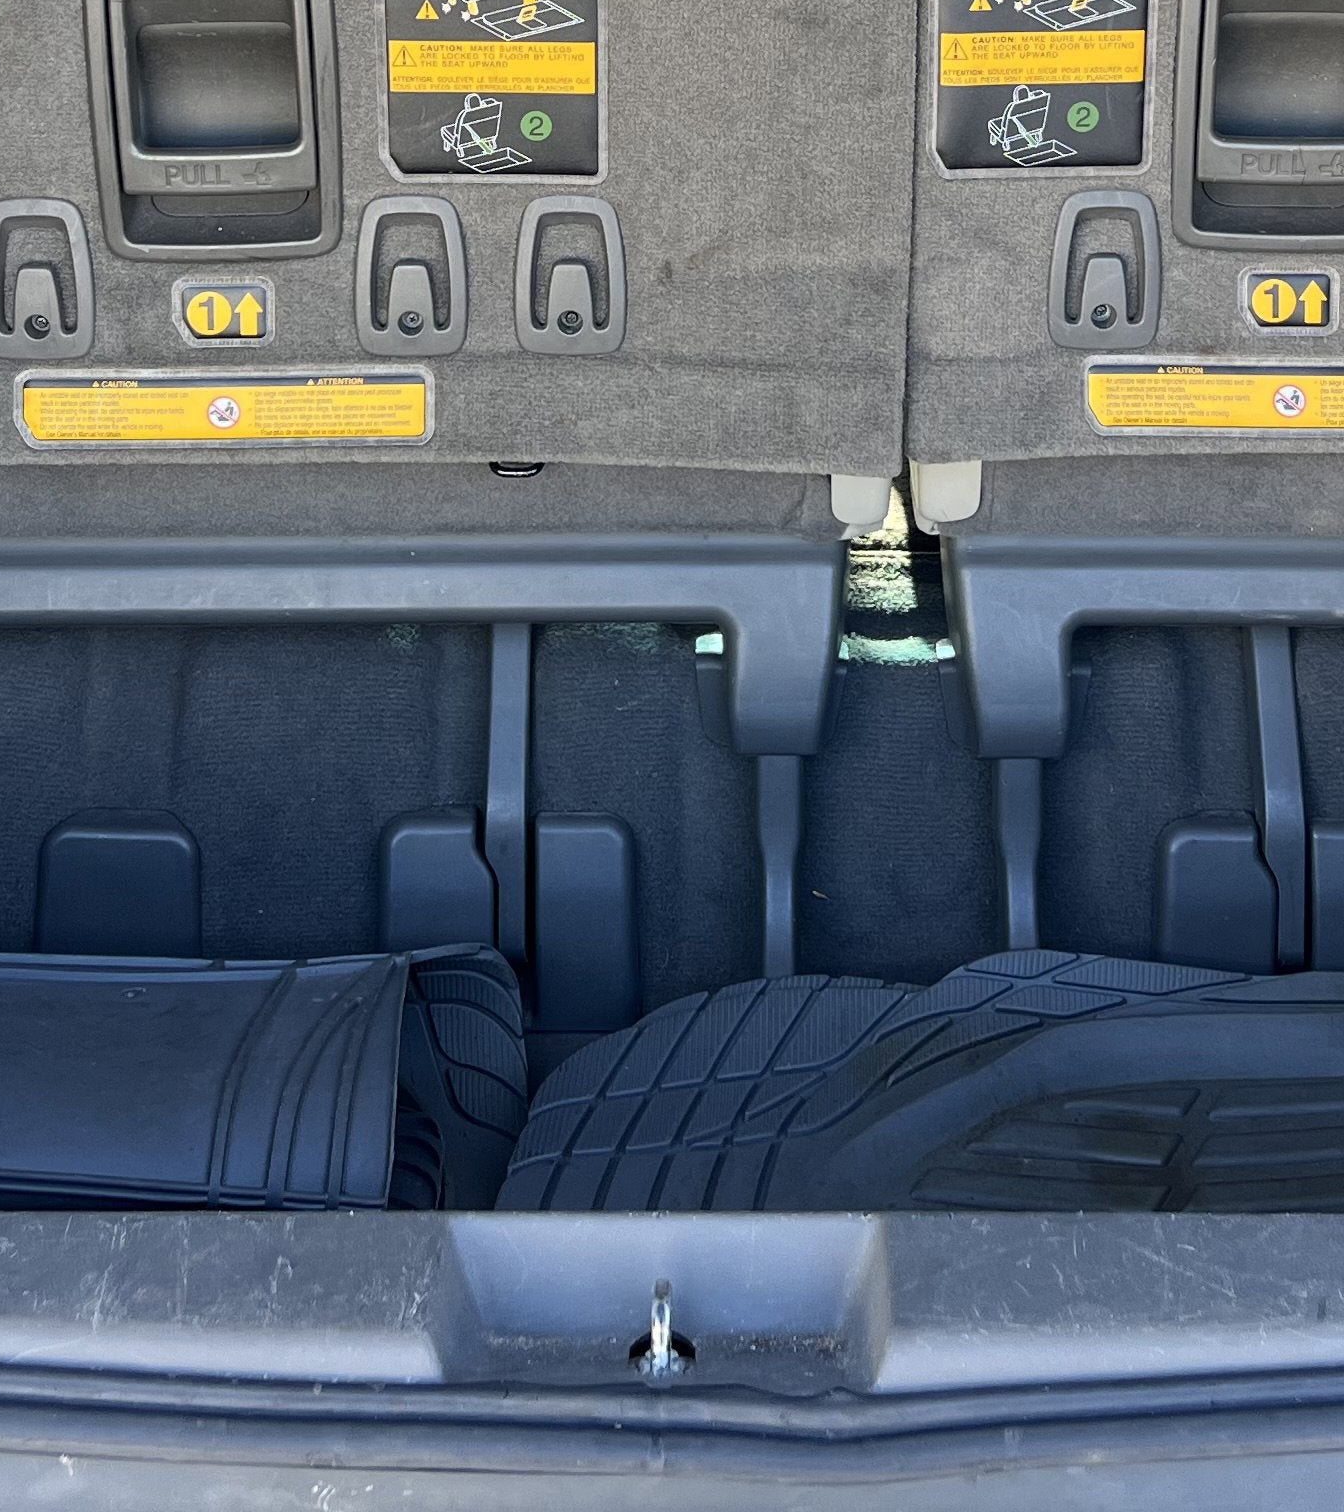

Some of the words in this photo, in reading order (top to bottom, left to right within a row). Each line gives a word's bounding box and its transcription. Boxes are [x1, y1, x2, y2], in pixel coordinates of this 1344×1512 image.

[1099, 42, 1135, 50] LIFTING
[529, 117, 544, 136] 2
[1076, 107, 1091, 127] 2
[165, 165, 231, 187] PULL
[1241, 154, 1306, 176] PULL
[1264, 284, 1279, 318] 1
[199, 296, 215, 330] 1
